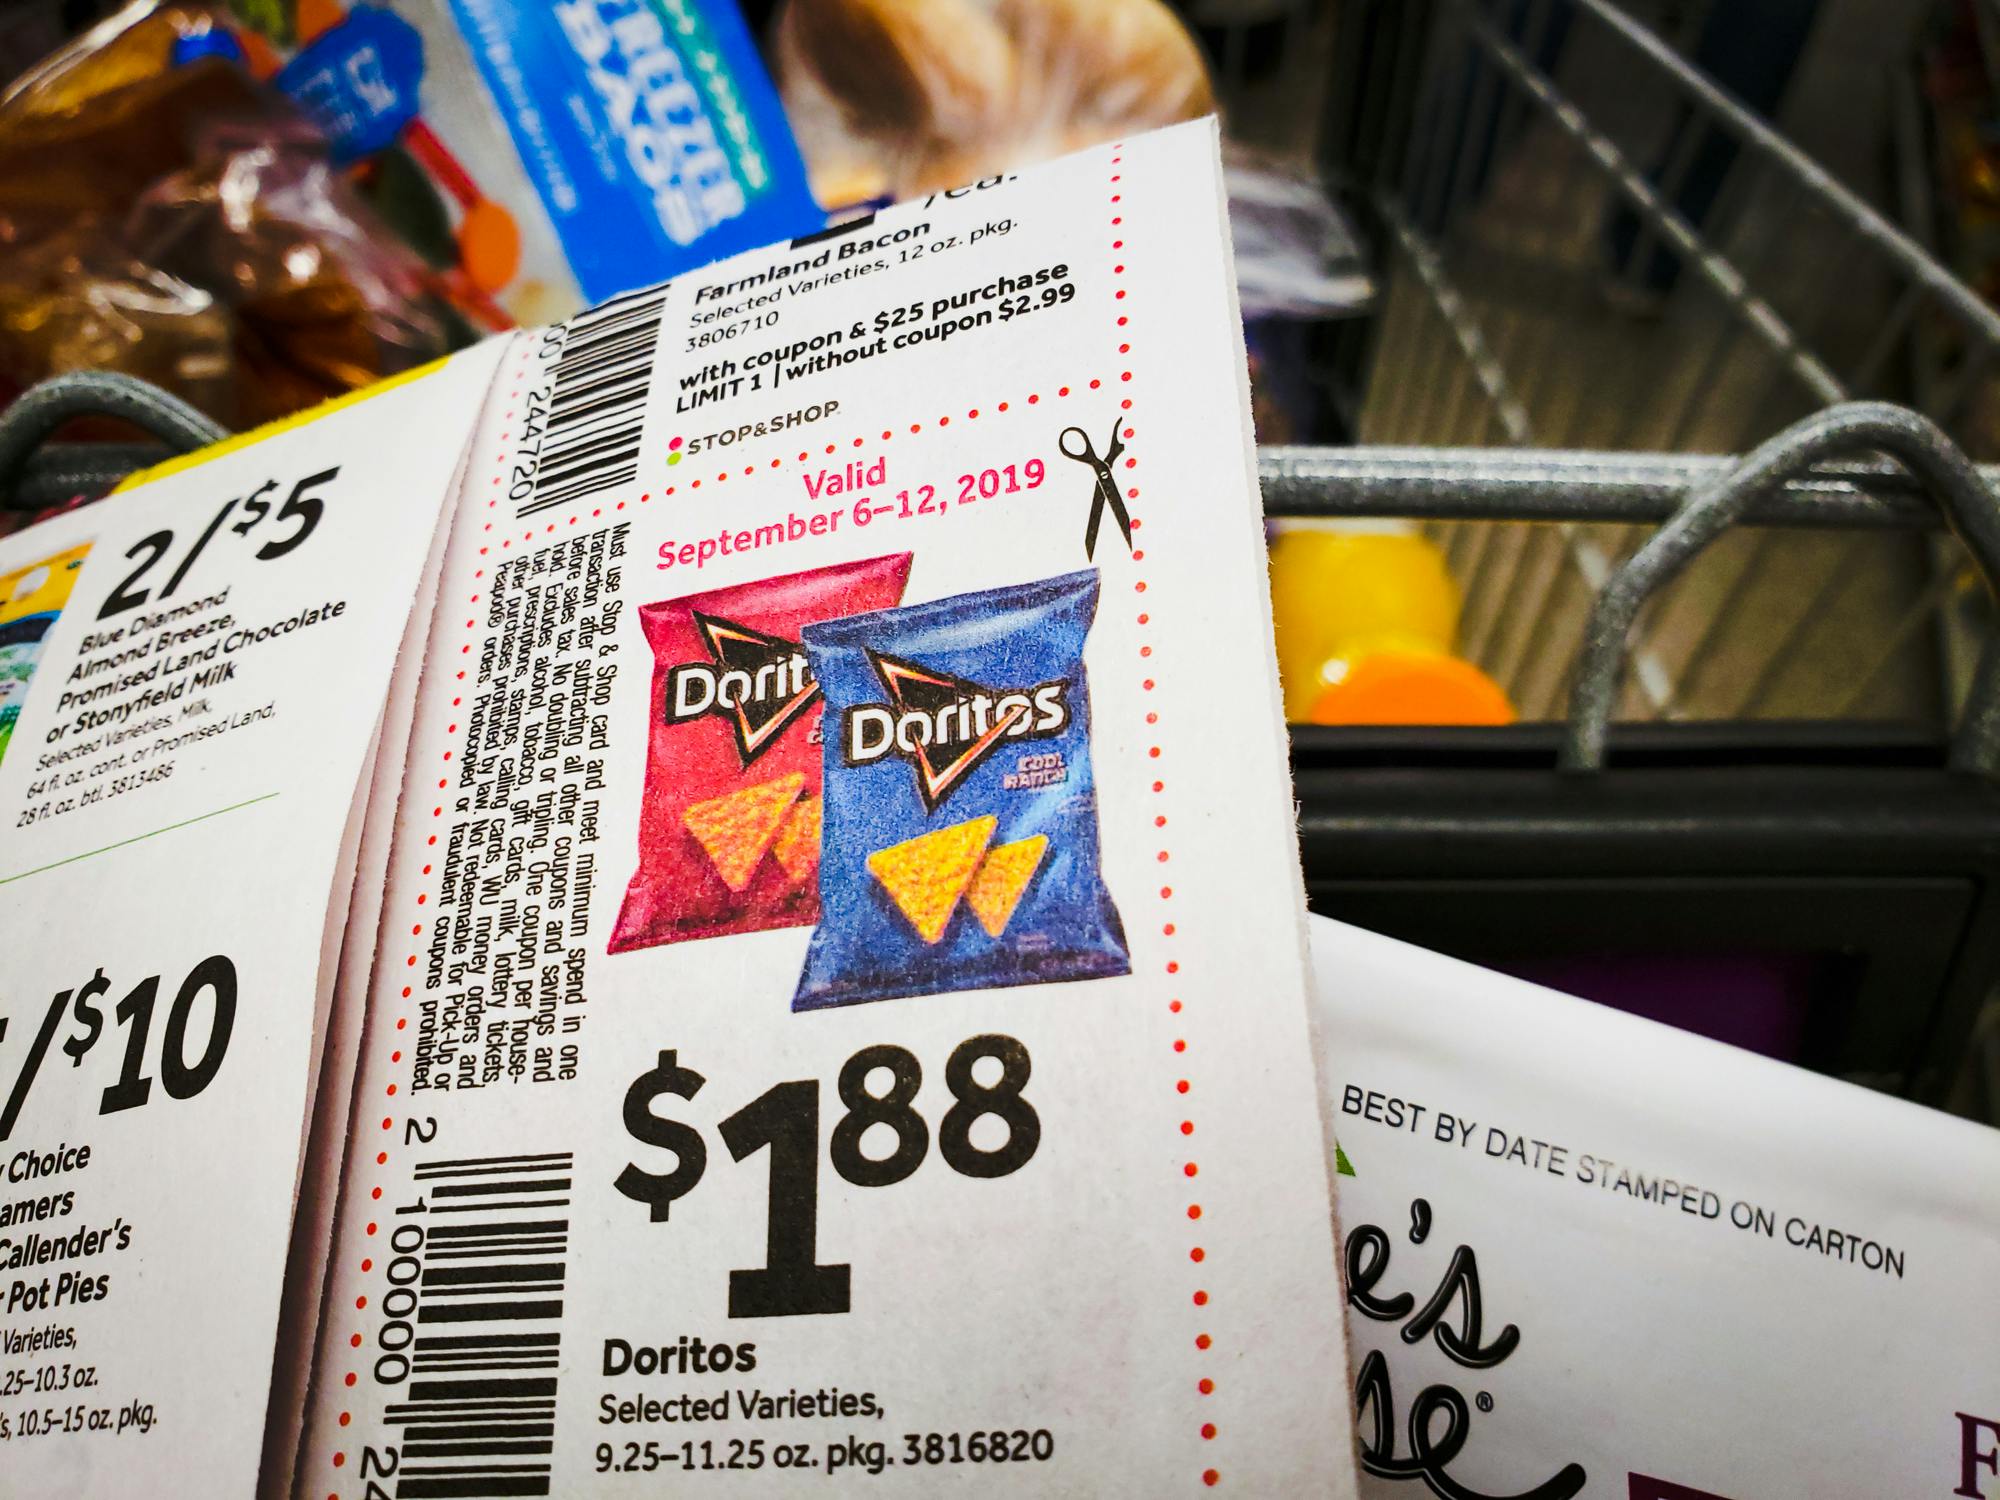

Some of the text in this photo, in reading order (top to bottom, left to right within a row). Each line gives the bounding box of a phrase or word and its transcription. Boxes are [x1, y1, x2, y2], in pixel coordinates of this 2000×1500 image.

[690, 219, 1017, 328] Selected Varieties, 12 oz. pkg.
[696, 223, 930, 305] Farmland Bacon
[677, 283, 1075, 414] LIMIT 1 without coupon $2.99
[680, 262, 1069, 390] with coupon & $25 purchase
[686, 311, 778, 352] 3806710
[509, 386, 551, 500] 244720
[687, 401, 840, 455] STOP&SHOP
[657, 508, 845, 570] September
[958, 459, 1044, 504] 2019
[804, 456, 886, 502] Valid
[95, 465, 342, 622] 2/$5
[56, 601, 346, 713] Promised Land Chocolate
[66, 612, 236, 685] Almond Breeze,
[78, 586, 231, 656] Blue Diamond
[47, 661, 239, 743] or Stonyfield Milk
[674, 652, 817, 718] Dorit
[849, 686, 1066, 762] Doritos
[27, 781, 46, 799] 64
[65, 771, 85, 788] oz.
[88, 755, 127, 779] cont.
[132, 749, 150, 766] or
[153, 718, 228, 757] Promised
[232, 701, 276, 732] Land,
[36, 740, 101, 771] Selected
[17, 808, 37, 827] 28
[56, 796, 76, 815] oz.
[80, 787, 103, 807] btl.
[108, 762, 175, 798] 3813486
[411, 561, 514, 1096] Peapod® orders. Photocopied or fraudulent coupons prohibited.
[431, 556, 530, 1091] other purchases prohibited by law. Not redeemable for Pick-Up or
[457, 548, 551, 1089] fuel, prescriptions, stamps, calling cards, WU money orders and
[474, 541, 570, 1088] hold. Excludes alcohol, tobacco, gift cards, milk, lottery tickets,
[508, 534, 590, 1084] before sales tax. No doubling or tripling. One coupon per house-
[531, 529, 610, 1082] transaction after subtracting all other coupons and savings and
[558, 522, 631, 1080] Must use Stop & Shop card and meet minimum spend in one
[0, 955, 238, 1143] /$10
[8, 1143, 91, 1184] Choice
[404, 1117, 438, 1146] 2
[1342, 1085, 1904, 1278] BEST BY DATE STAMPED ON CARTON
[7, 1271, 110, 1314] Pot Pies
[374, 1197, 428, 1385] 100000
[5, 1323, 76, 1358] Varieties,
[73, 1367, 98, 1388] oz.
[603, 1336, 756, 1376] Doritos
[17, 1398, 157, 1436] 10.5–15 oz. pkg.
[598, 1387, 884, 1424] Selected Varieties,
[596, 1429, 1054, 1475] 9.25–11.25 oz. pkg. 3816820
